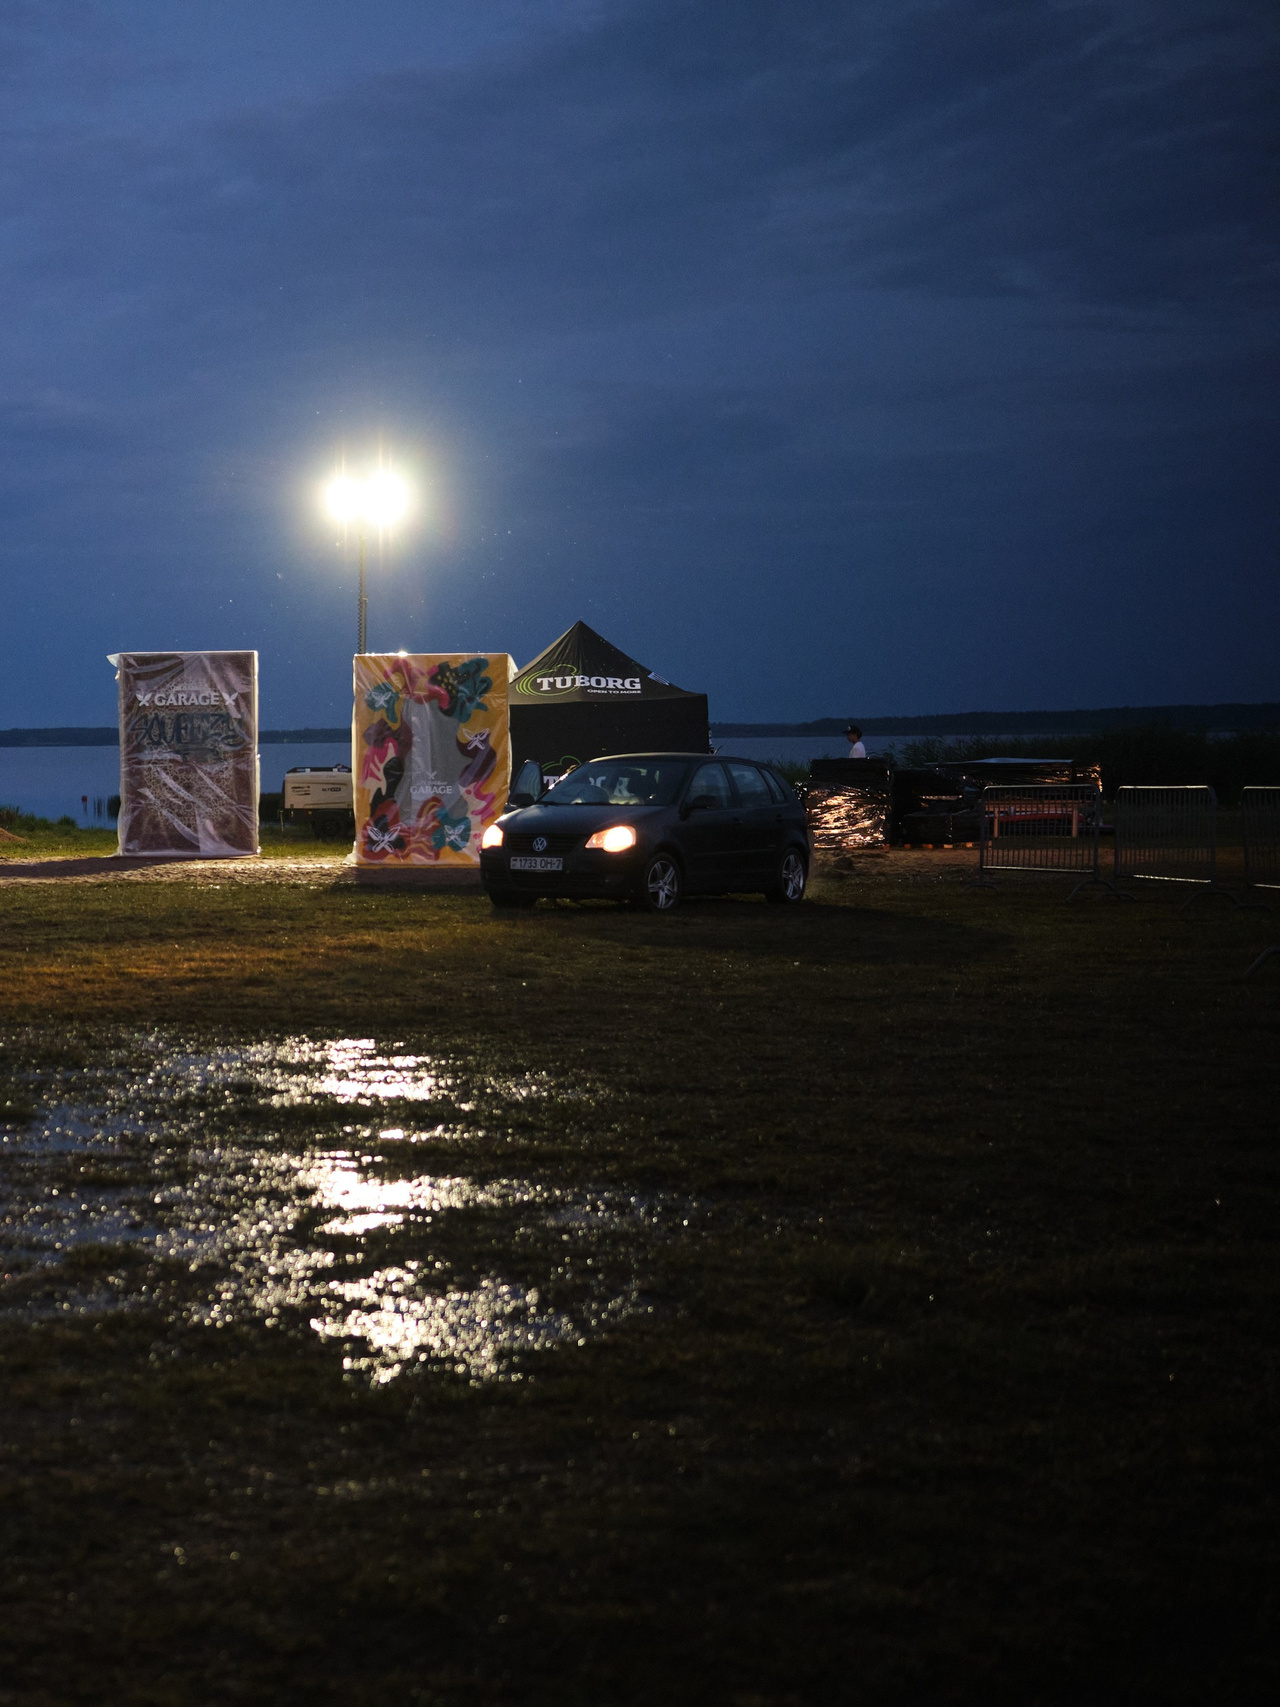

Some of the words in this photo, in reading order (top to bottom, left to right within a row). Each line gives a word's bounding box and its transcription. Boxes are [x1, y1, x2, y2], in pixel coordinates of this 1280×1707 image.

[536, 675, 641, 691] TUBORG
[154, 692, 219, 706] GARAGE
[409, 785, 452, 794] GARAGE
[519, 858, 537, 868] 1733
